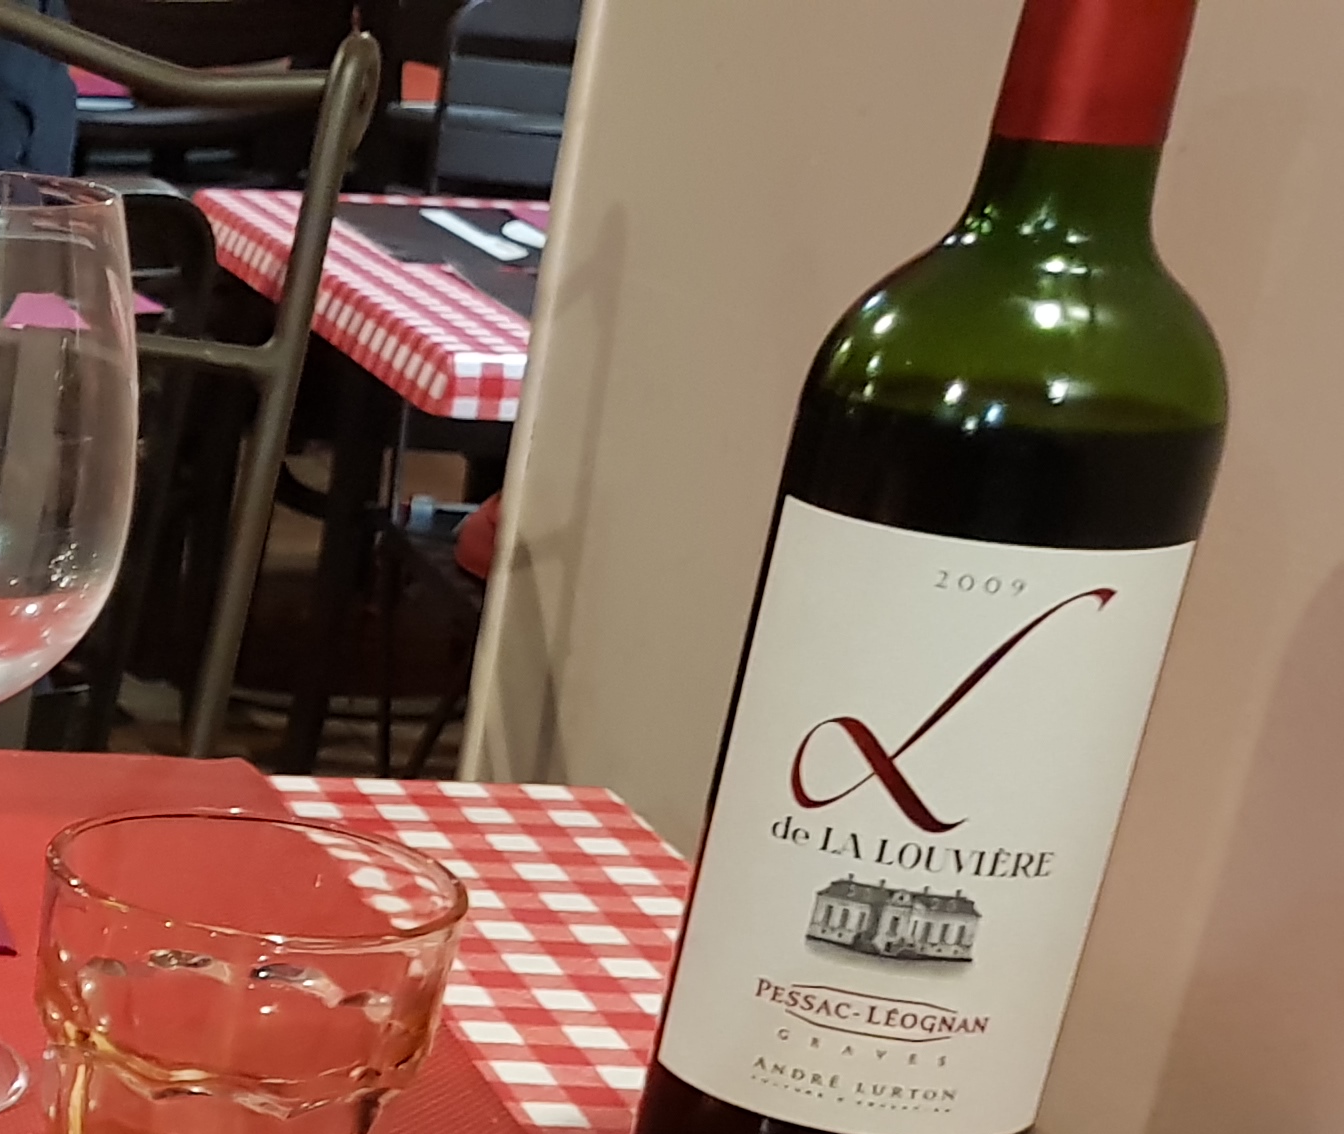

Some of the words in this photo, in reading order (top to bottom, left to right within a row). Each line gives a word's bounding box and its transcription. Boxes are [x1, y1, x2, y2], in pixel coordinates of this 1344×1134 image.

[934, 569, 1028, 598] 2009
[771, 816, 810, 845] de
[819, 826, 862, 860] LA
[874, 838, 1055, 879] LOUVIÈRE
[755, 977, 990, 1034] PESSAC-LÉOGNAN
[777, 1028, 947, 1067] GRAVES
[753, 1056, 840, 1089] ANDRÉ
[855, 1081, 957, 1101] LURTON
